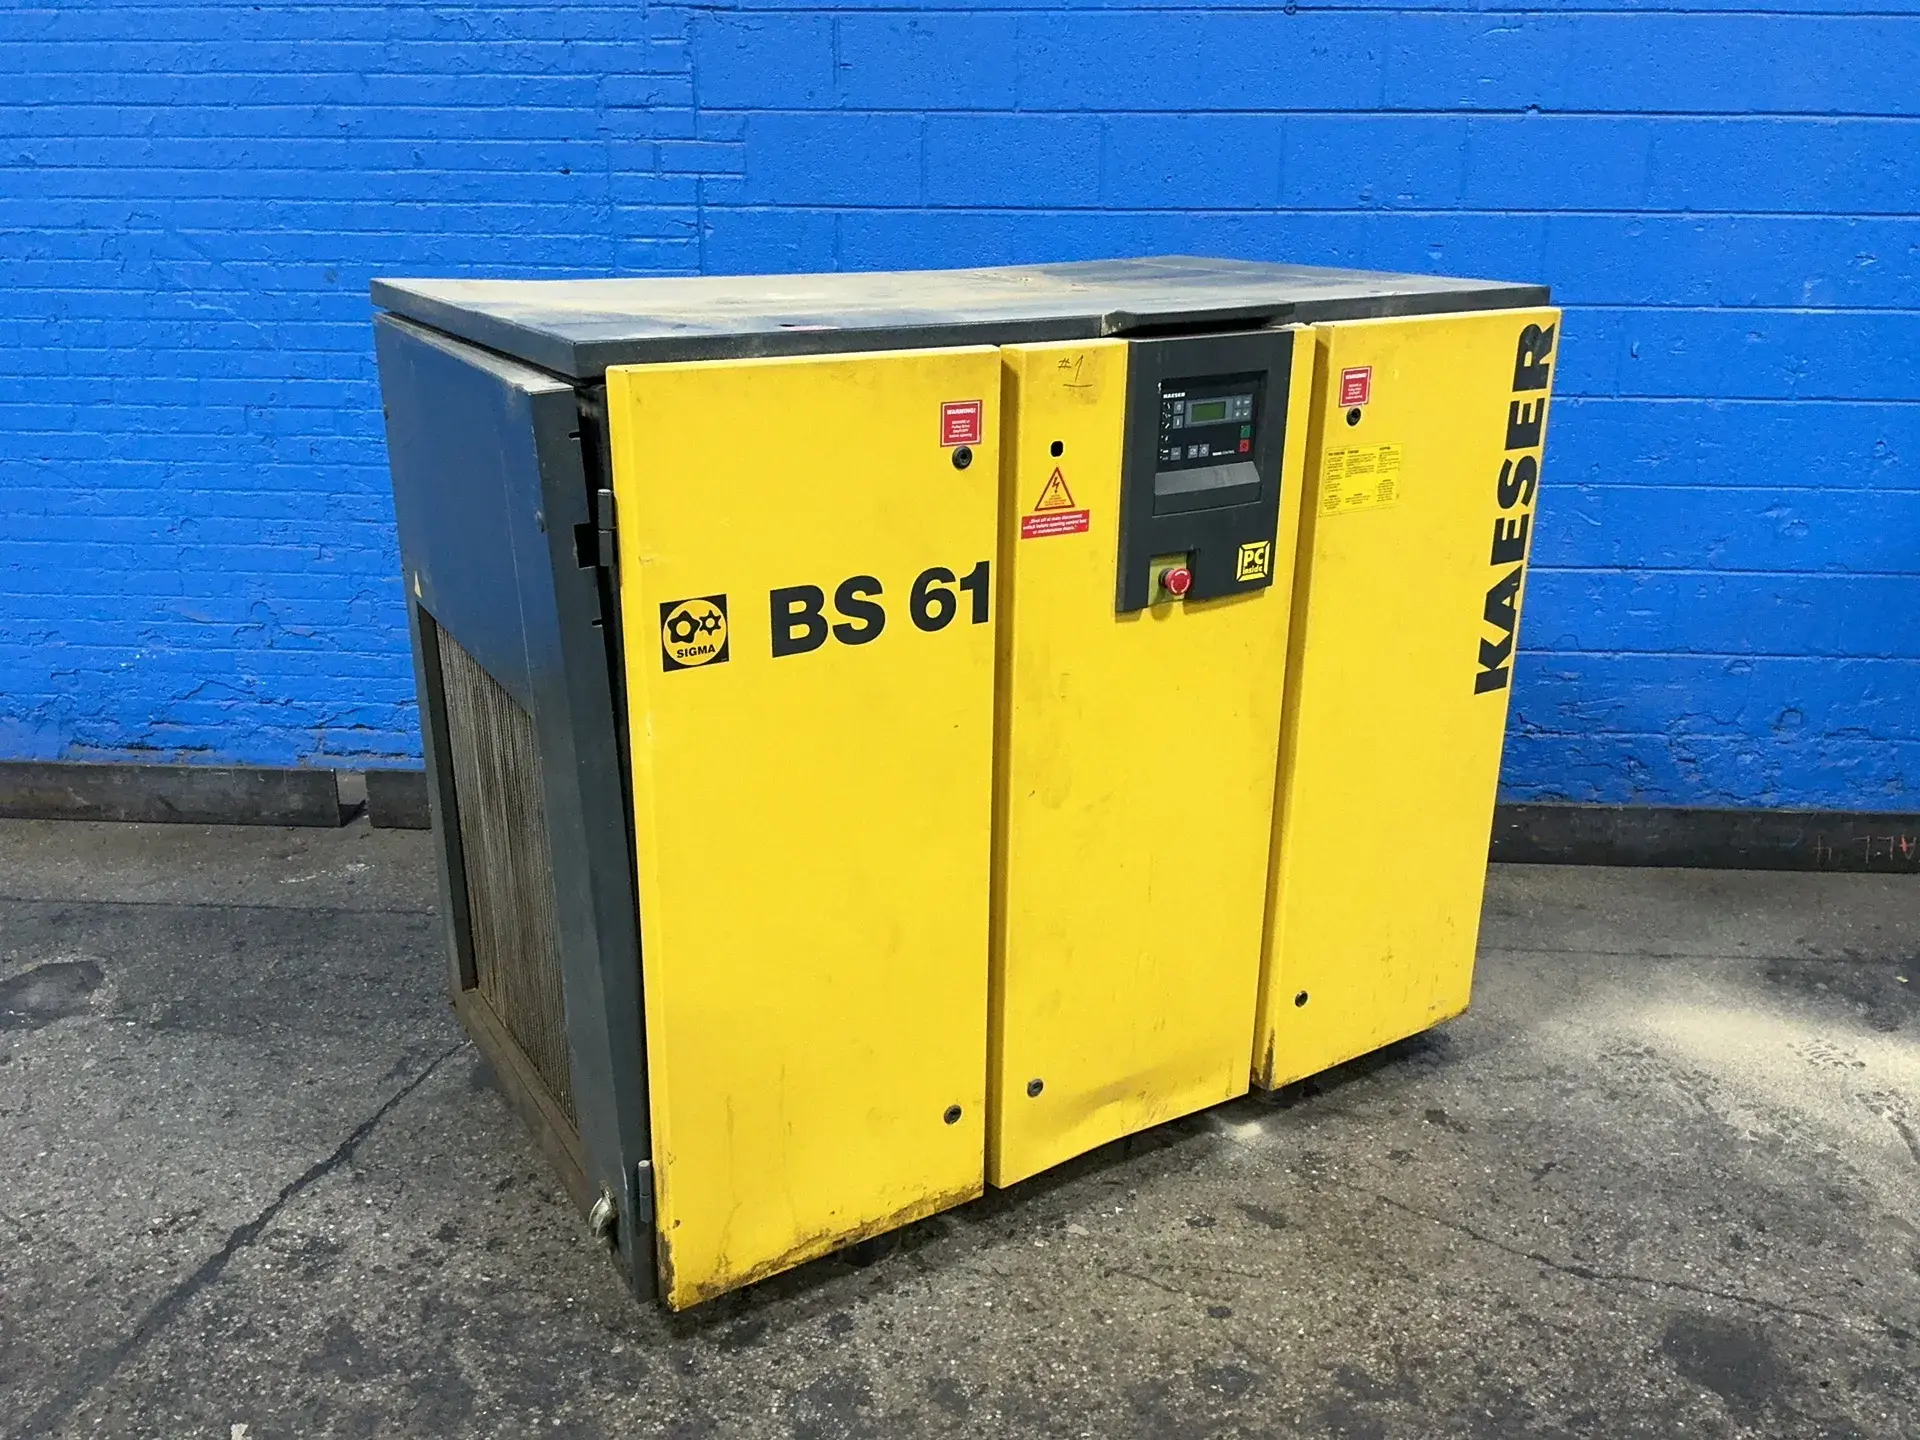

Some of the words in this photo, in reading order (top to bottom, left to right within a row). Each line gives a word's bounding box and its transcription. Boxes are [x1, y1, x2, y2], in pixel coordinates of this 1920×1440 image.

[1474, 322, 1555, 695] KAESER
[1243, 547, 1265, 566] PC
[769, 574, 886, 659] BS
[909, 560, 990, 633] 61
[676, 644, 716, 659] SIGMA
